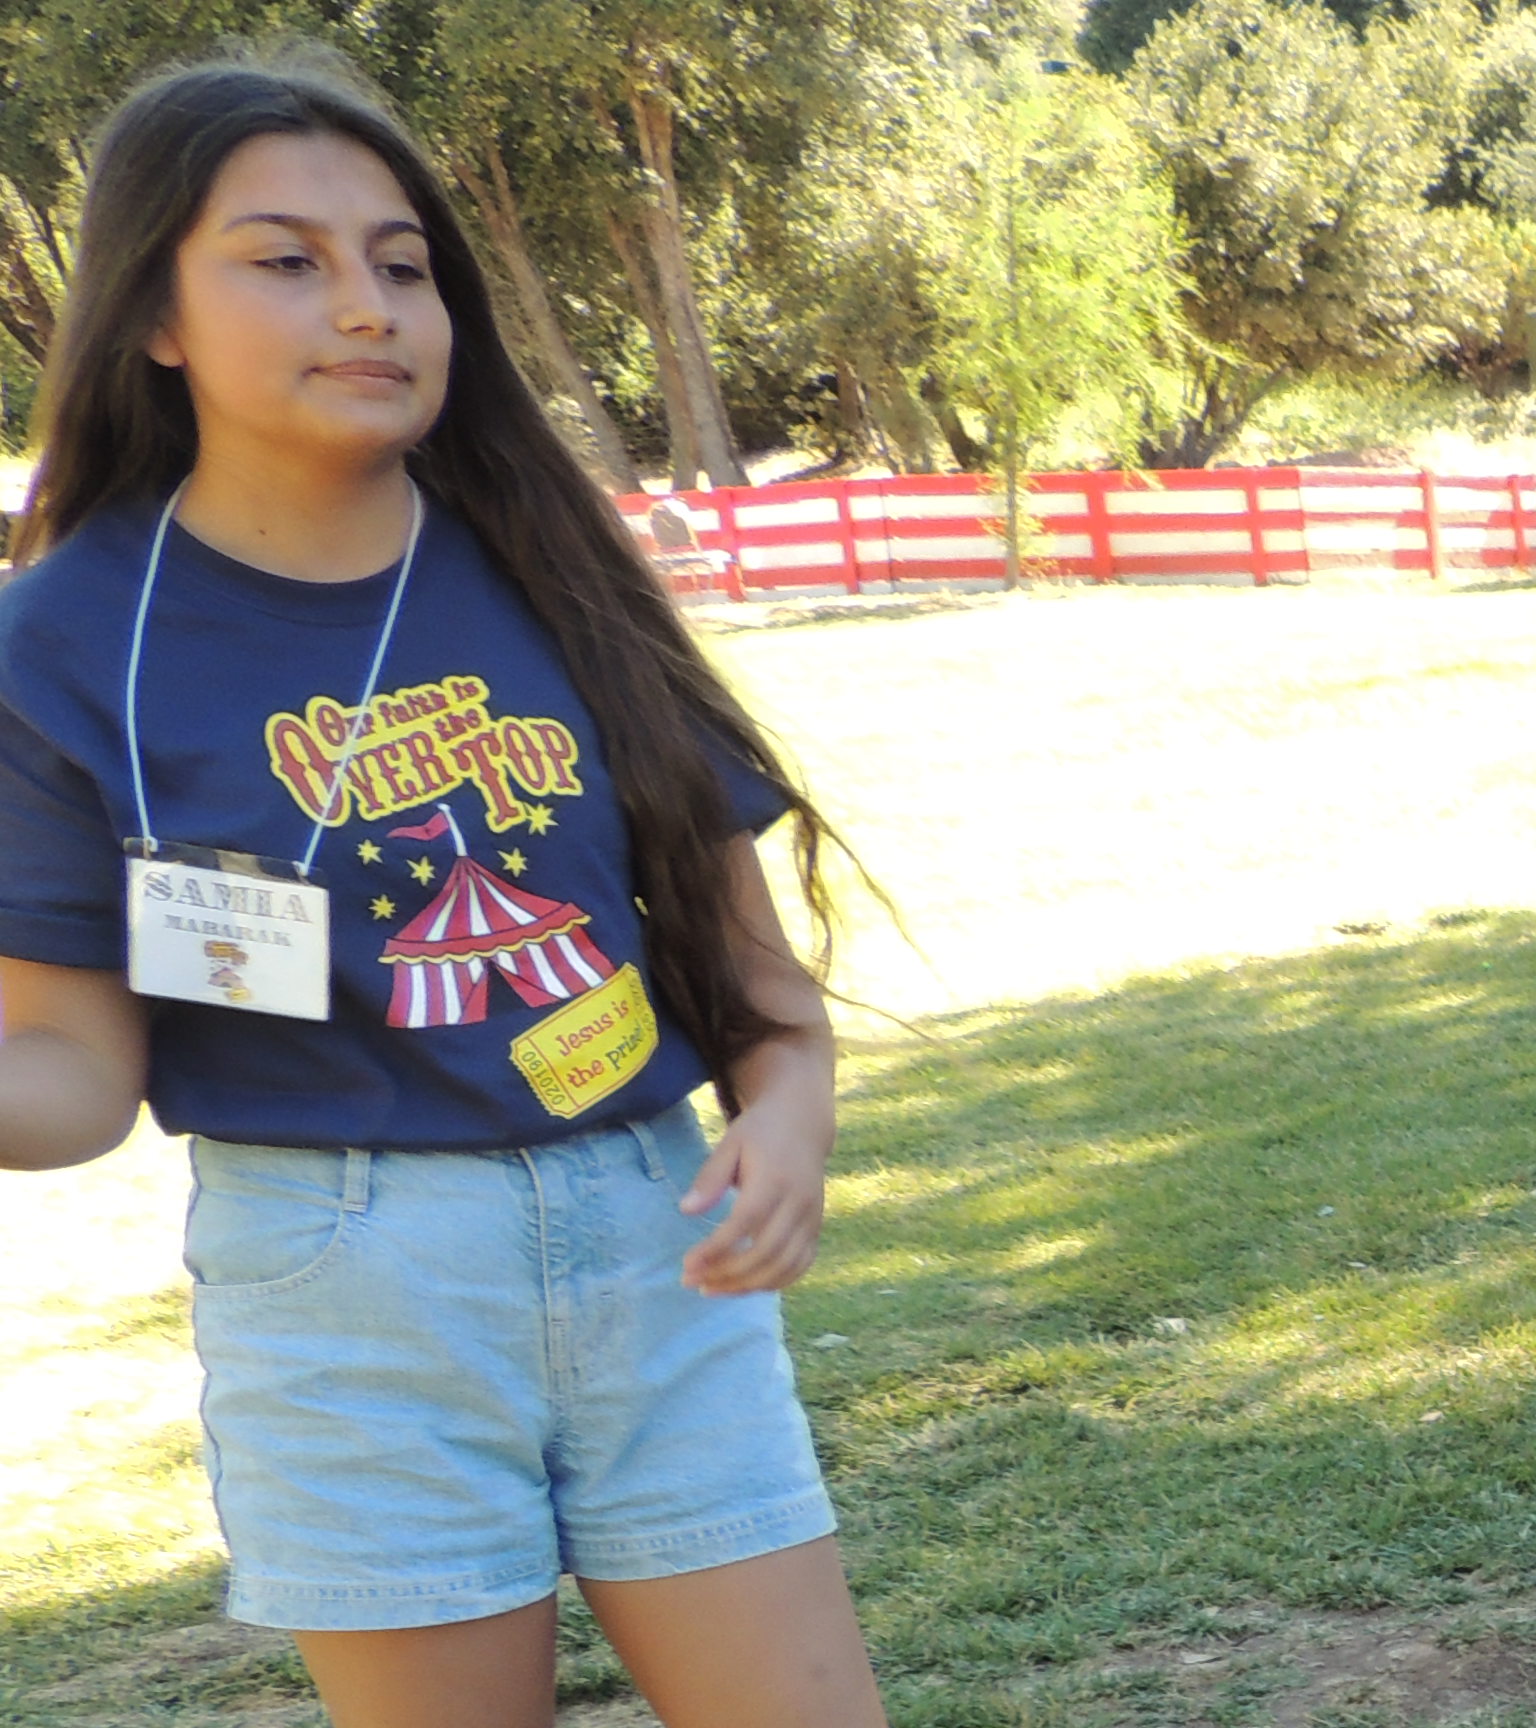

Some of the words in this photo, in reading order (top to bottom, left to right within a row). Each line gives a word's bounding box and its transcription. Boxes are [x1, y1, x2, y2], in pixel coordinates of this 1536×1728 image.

[316, 703, 374, 746] Our
[377, 688, 449, 728] faith
[451, 680, 480, 701] is
[433, 707, 482, 742] the
[273, 717, 455, 821] OVER
[450, 722, 577, 826] TOP
[555, 1012, 615, 1057] Jesus
[610, 999, 631, 1020] is
[567, 1059, 605, 1088] the
